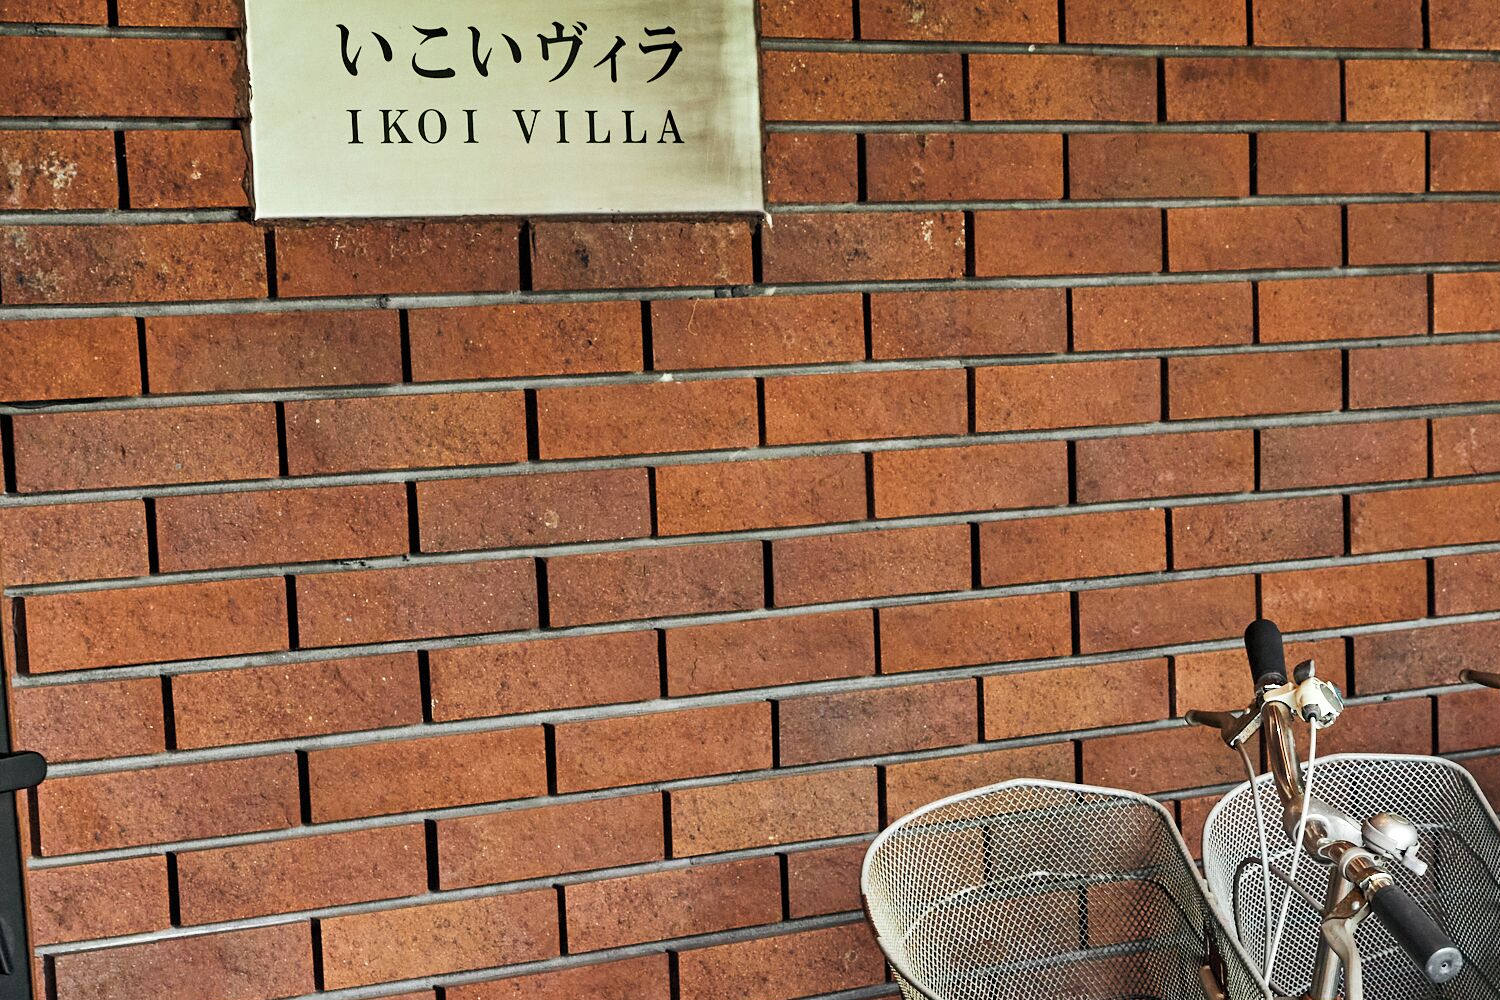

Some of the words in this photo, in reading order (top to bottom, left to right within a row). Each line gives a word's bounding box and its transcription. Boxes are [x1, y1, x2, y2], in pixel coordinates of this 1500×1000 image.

[335, 21, 683, 83] いこいヴィラ
[346, 108, 479, 144] IKOI
[512, 108, 685, 144] VILLA
